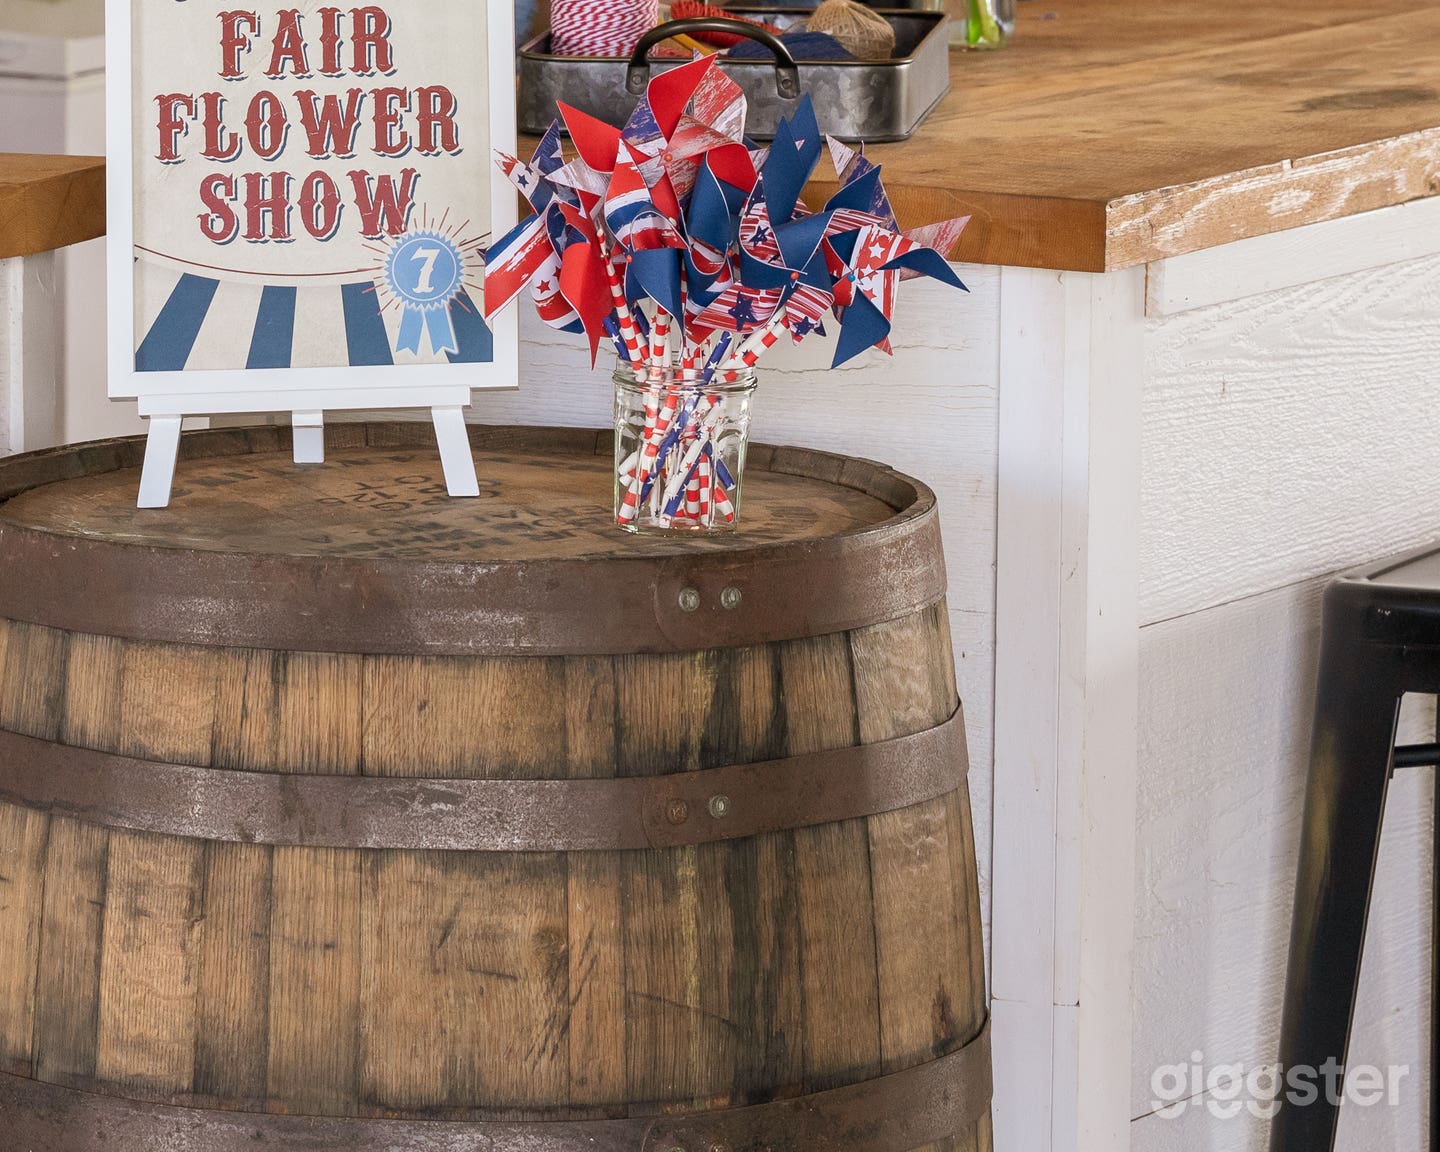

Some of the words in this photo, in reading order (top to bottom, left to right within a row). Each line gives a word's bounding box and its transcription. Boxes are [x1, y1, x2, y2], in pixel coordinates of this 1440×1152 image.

[216, 5, 398, 81] FAIR
[154, 84, 463, 166] FLOWER
[197, 167, 418, 245] SHOW
[411, 246, 437, 304] 7
